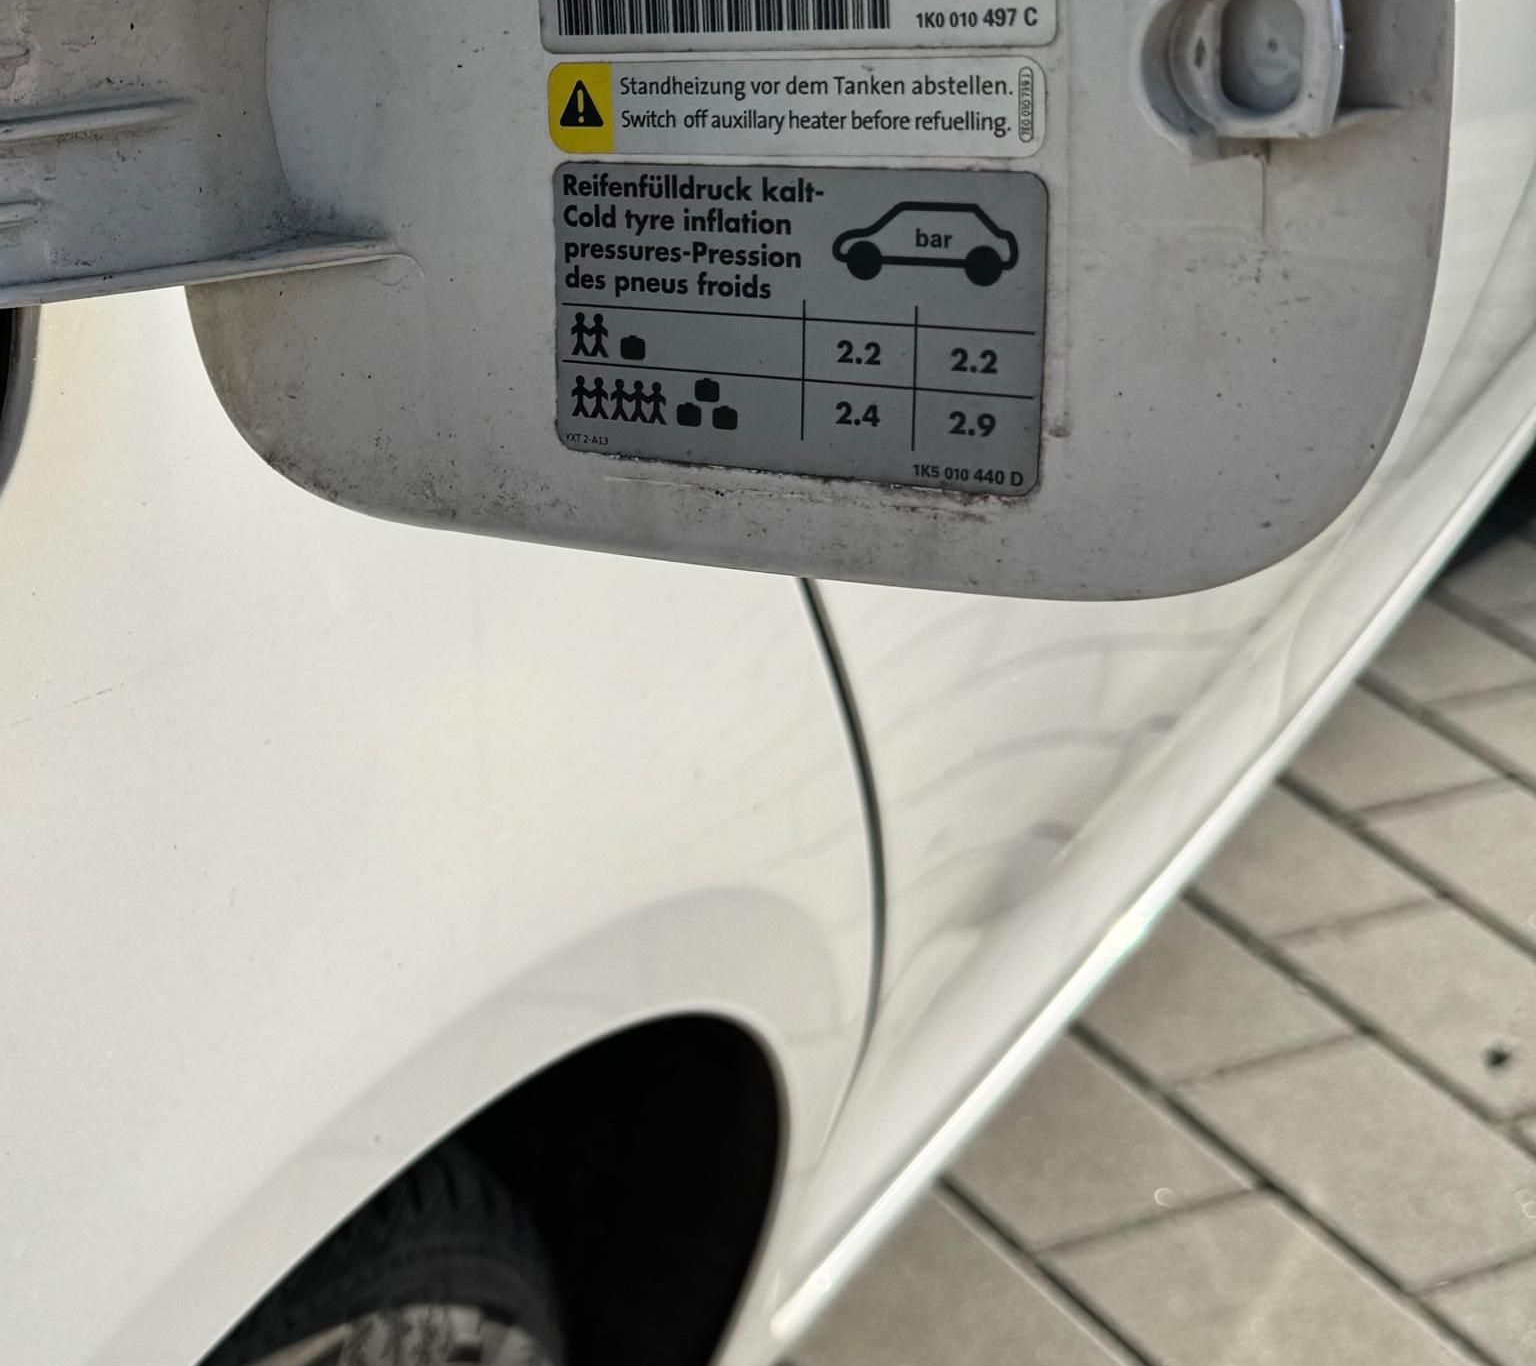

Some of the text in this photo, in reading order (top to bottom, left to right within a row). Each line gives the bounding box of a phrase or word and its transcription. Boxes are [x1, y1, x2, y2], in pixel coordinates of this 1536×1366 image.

[915, 6, 1038, 28] 1K0 010 497 C
[619, 75, 1014, 102] Standheizung vor dem Tanken abstellen.
[621, 108, 1012, 138] Switch off auxillary heater before refuelling.
[563, 172, 825, 204] Reifenfülldruck kalt-
[563, 203, 792, 237] Cold tyre inflation
[914, 227, 953, 250] bar
[564, 241, 802, 269] pressures-Pression
[565, 265, 772, 300] des pneus froids
[835, 339, 999, 375] 2.2 2.2
[834, 401, 997, 437] 2.4 2.9
[912, 464, 1024, 487] 1K5 010 440 D
